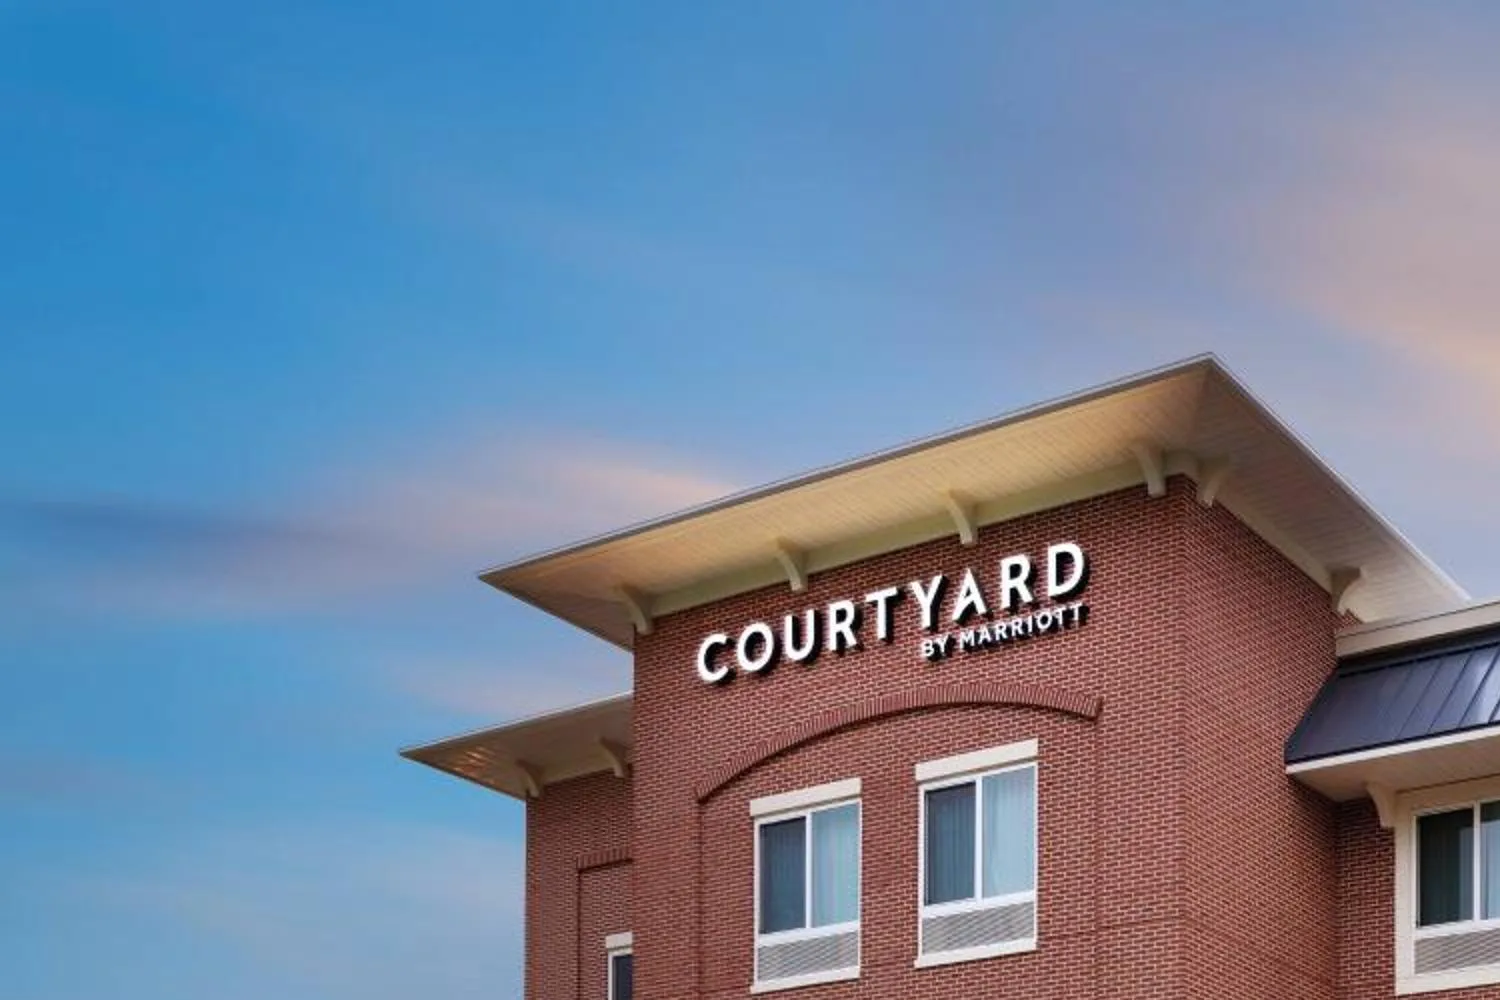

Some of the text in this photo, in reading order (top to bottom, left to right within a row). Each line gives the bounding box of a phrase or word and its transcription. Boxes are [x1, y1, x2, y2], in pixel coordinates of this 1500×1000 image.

[698, 541, 1087, 683] COURTYARD
[922, 601, 1086, 659] BY MARRIOTT
